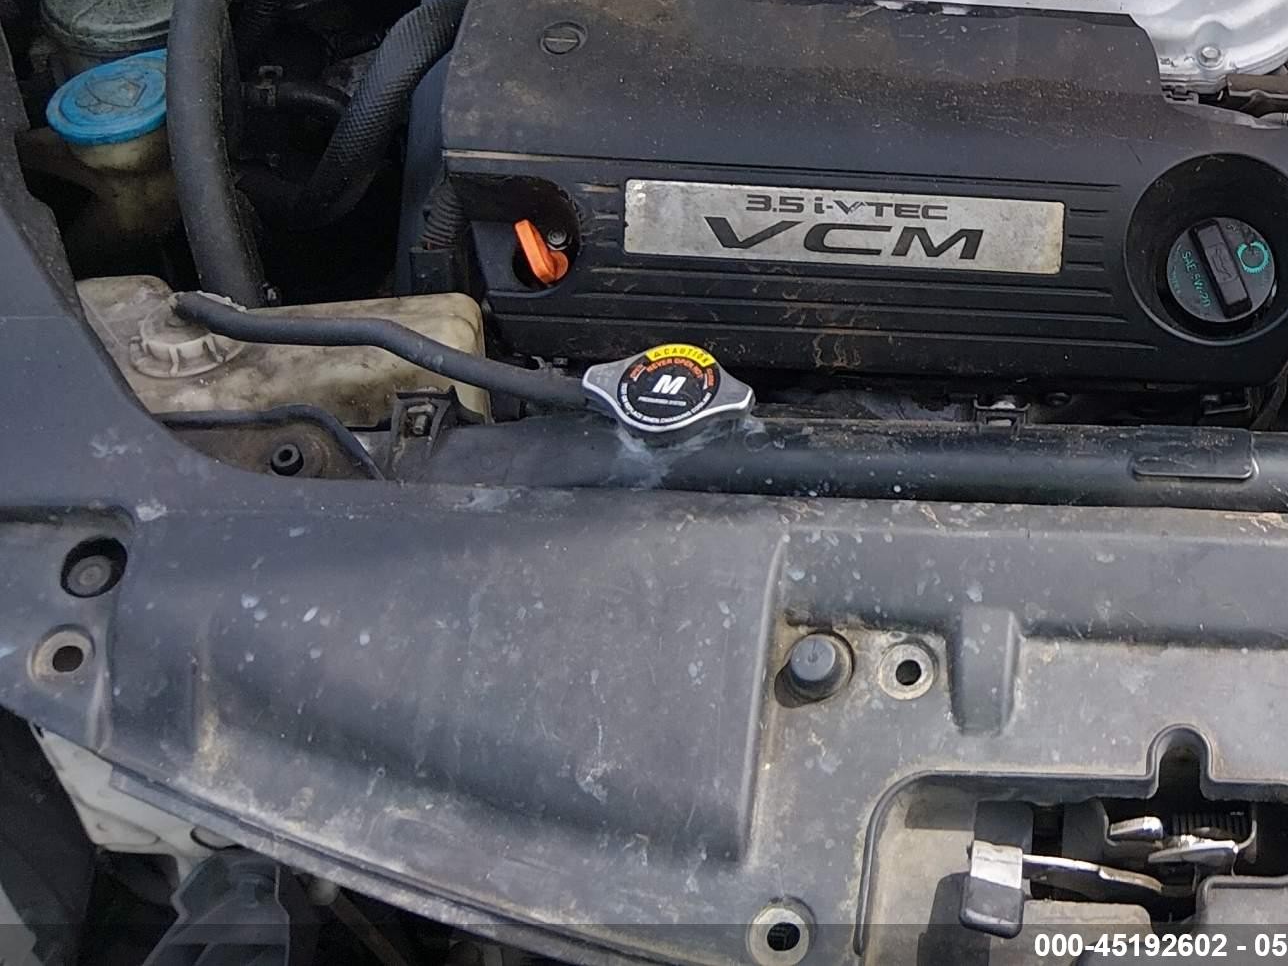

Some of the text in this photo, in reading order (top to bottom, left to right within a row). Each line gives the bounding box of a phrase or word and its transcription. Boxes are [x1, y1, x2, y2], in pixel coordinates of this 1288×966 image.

[745, 194, 949, 221] 3.5 i-VTEC
[704, 216, 985, 260] VCM
[1182, 250, 1198, 273] SAE
[652, 375, 686, 394] M
